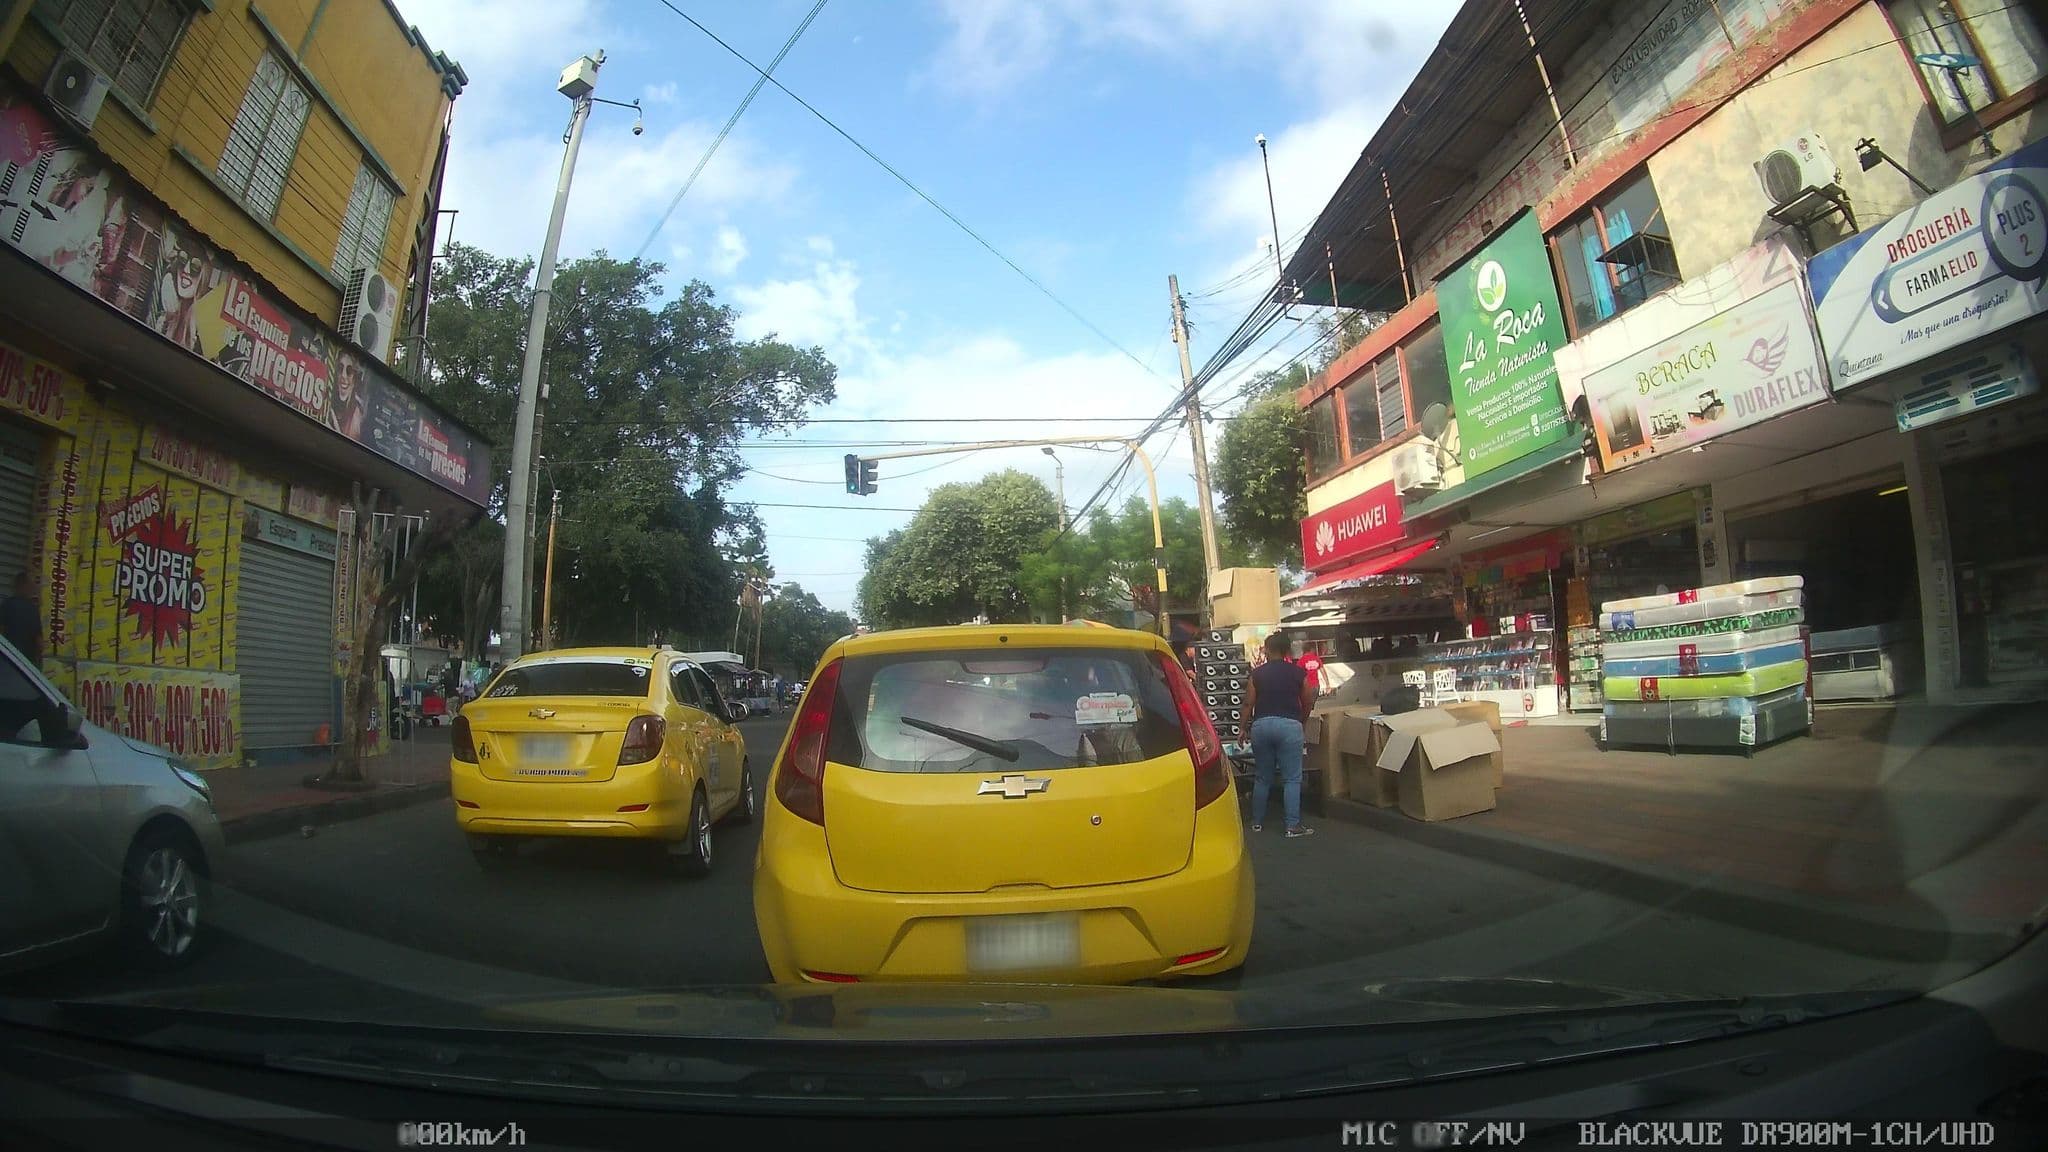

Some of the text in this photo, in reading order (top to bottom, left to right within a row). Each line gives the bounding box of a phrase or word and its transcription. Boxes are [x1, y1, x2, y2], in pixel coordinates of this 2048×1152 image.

[1886, 206, 1974, 264] DROGUERÍA
[1996, 199, 2036, 235] PLUS
[2020, 233, 2033, 257] 2
[224, 277, 251, 324] La
[1459, 301, 1546, 374] La Roca
[1925, 322, 1941, 339] que
[1943, 313, 1960, 330] una
[236, 331, 252, 357] los
[249, 339, 326, 410] precios
[1465, 340, 1549, 397] Tienda Naturista
[1635, 341, 1718, 396] BERACA
[1733, 364, 1820, 419] DURAFLEX
[110, 493, 161, 538] PRECIOS
[1337, 503, 1388, 542] HUAWEI
[132, 542, 193, 580] SUPER
[114, 563, 206, 613] PROMO
[123, 682, 162, 749] 30%
[165, 685, 199, 755] 40%
[201, 687, 234, 755] 50%
